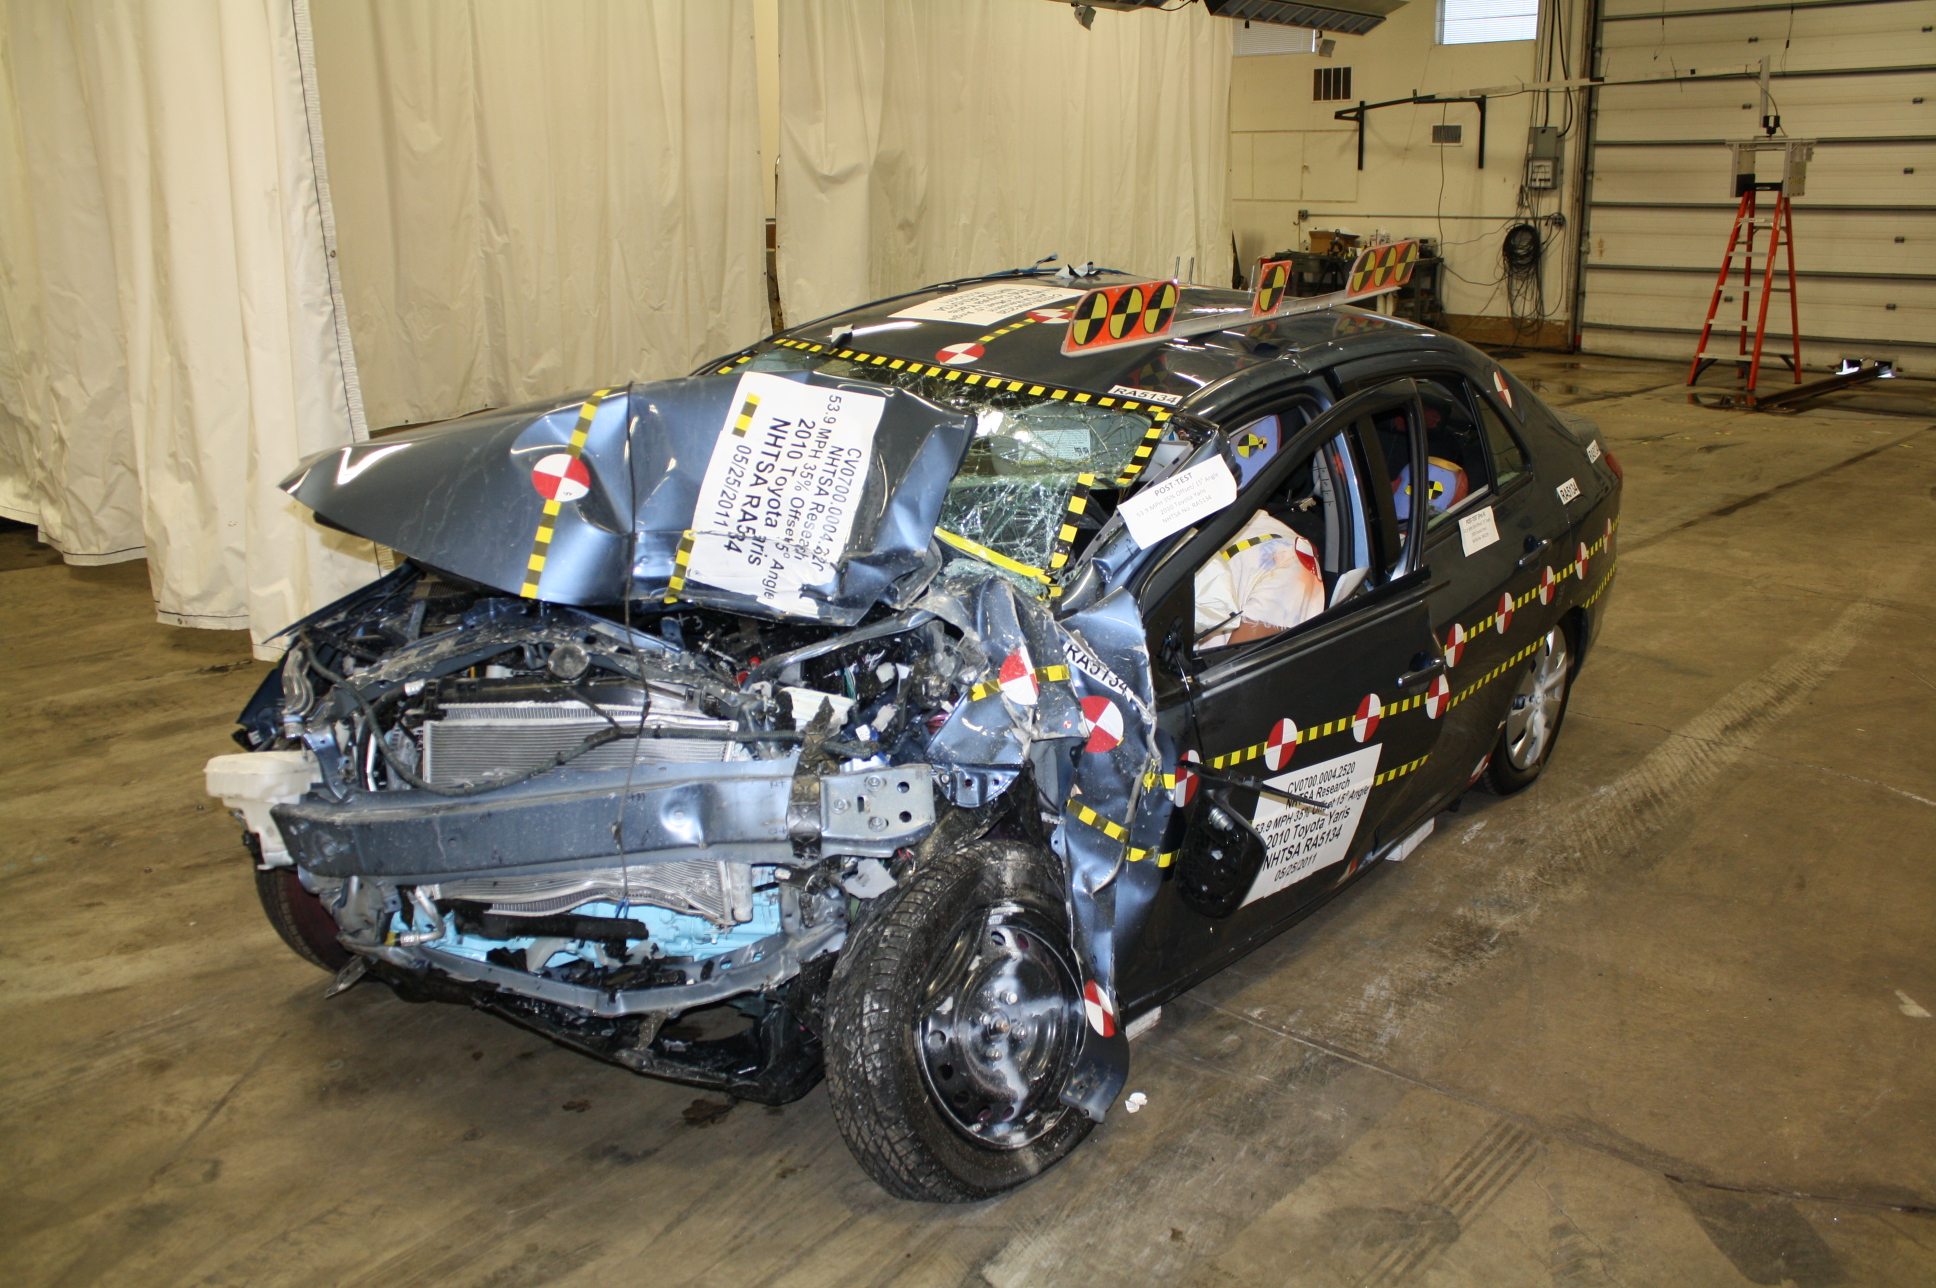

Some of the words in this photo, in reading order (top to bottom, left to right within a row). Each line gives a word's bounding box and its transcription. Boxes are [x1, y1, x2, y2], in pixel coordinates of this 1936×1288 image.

[823, 394, 842, 424] 53.9
[1114, 387, 1178, 404] RA5134
[750, 417, 791, 487] NHTSA
[787, 418, 815, 460] 2010
[808, 428, 832, 459] MPH
[713, 445, 752, 527] 05/25/2011
[794, 463, 817, 491] 35%
[814, 445, 845, 498] NHTSA
[1154, 472, 1193, 497] POST-TEST
[764, 466, 798, 528] Toyota
[1136, 507, 1151, 519] 53.9
[1149, 500, 1163, 512] MPH
[1164, 493, 1176, 503] 35%
[1204, 472, 1220, 483] Angle
[1160, 503, 1174, 515] 2010
[1174, 494, 1194, 509] Toyota
[1192, 488, 1207, 499] Yaris
[1162, 510, 1182, 524] NHTSA
[1191, 494, 1212, 509] RA5134
[723, 495, 761, 554] RA534
[748, 535, 768, 566] aris
[762, 558, 785, 600] Angle
[1288, 762, 1356, 794] CV0700.0004.2520
[1315, 778, 1351, 800] Research
[1255, 820, 1273, 835] 53.9
[1273, 812, 1294, 830] MPH
[1293, 808, 1310, 822] 35%
[1348, 785, 1371, 803] Angle
[1267, 829, 1291, 850] 2010
[1293, 818, 1326, 840] Toyota
[1328, 806, 1351, 826] Yaris
[1262, 842, 1301, 872] NHTSA
[1302, 824, 1343, 854] RA5134
[1274, 853, 1317, 882] 05/25/2011
